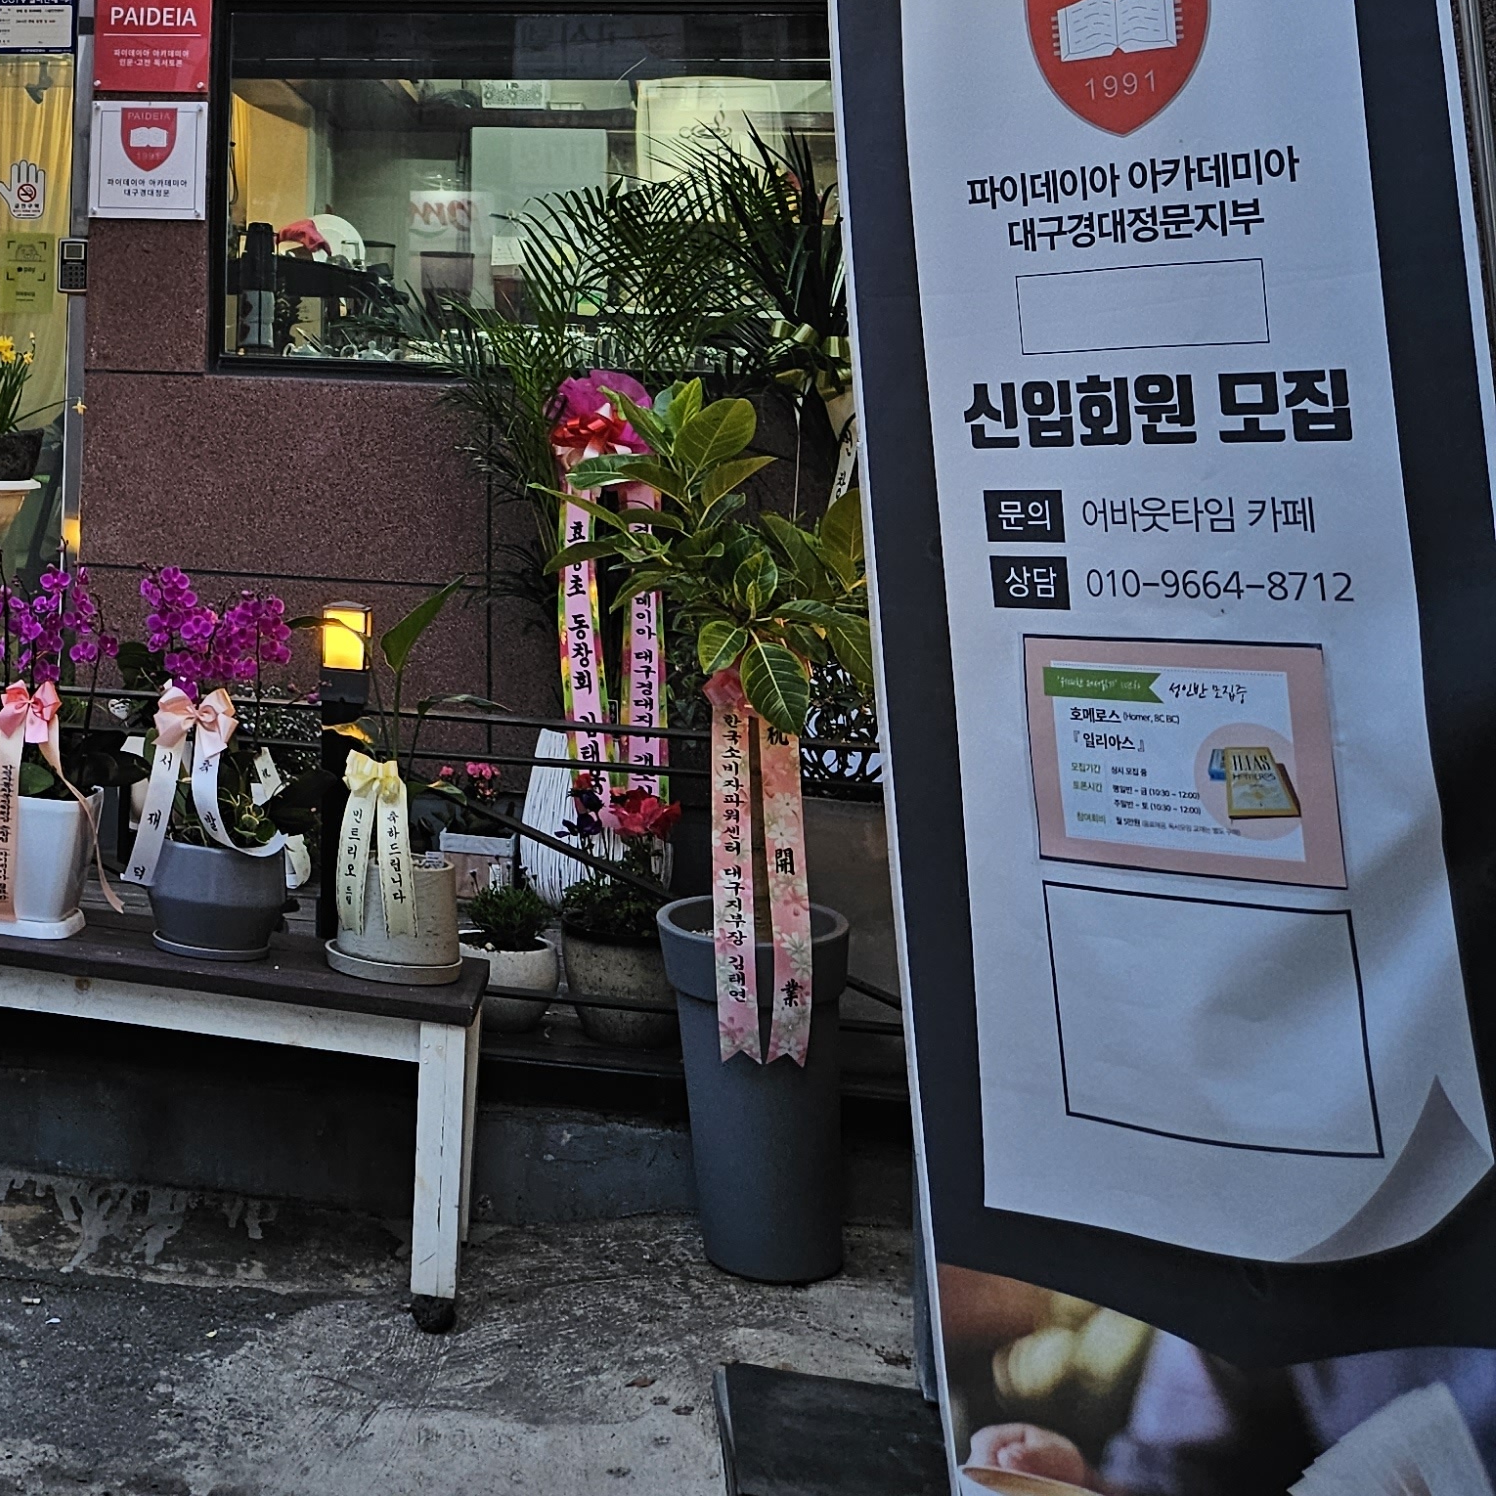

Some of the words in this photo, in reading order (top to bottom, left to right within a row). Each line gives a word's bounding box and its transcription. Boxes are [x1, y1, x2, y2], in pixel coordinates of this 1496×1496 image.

[109, 6, 198, 27] PAIDEIA
[113, 48, 150, 59] 파이데이아
[152, 48, 190, 59] 아카데미아
[1084, 69, 1158, 102] 1991
[127, 111, 172, 122] PAIDEIA
[106, 177, 146, 188] 파이데이아
[148, 177, 188, 189] 아카데미아
[966, 162, 1122, 211] 파이데이아
[1127, 145, 1301, 196] 아카데미아
[1007, 198, 1265, 254] 대구경대정문지부
[962, 370, 1200, 451] 신입회원
[1217, 367, 1355, 444] 모집
[997, 499, 1053, 532] 문의
[1081, 496, 1237, 534] 어바웃타임
[1247, 496, 1317, 534] 카페
[1004, 565, 1058, 600] 상담
[1086, 567, 1356, 603] 010-9664-8712
[567, 614, 595, 697] 동창회
[632, 649, 658, 744] 대구경대지
[1069, 706, 1122, 724] 호메로스
[721, 713, 744, 857] 한국소비자파워센터
[386, 810, 407, 905] 축하드립니다
[723, 864, 748, 946] 대구지부장
[727, 953, 747, 1004] 김태연
